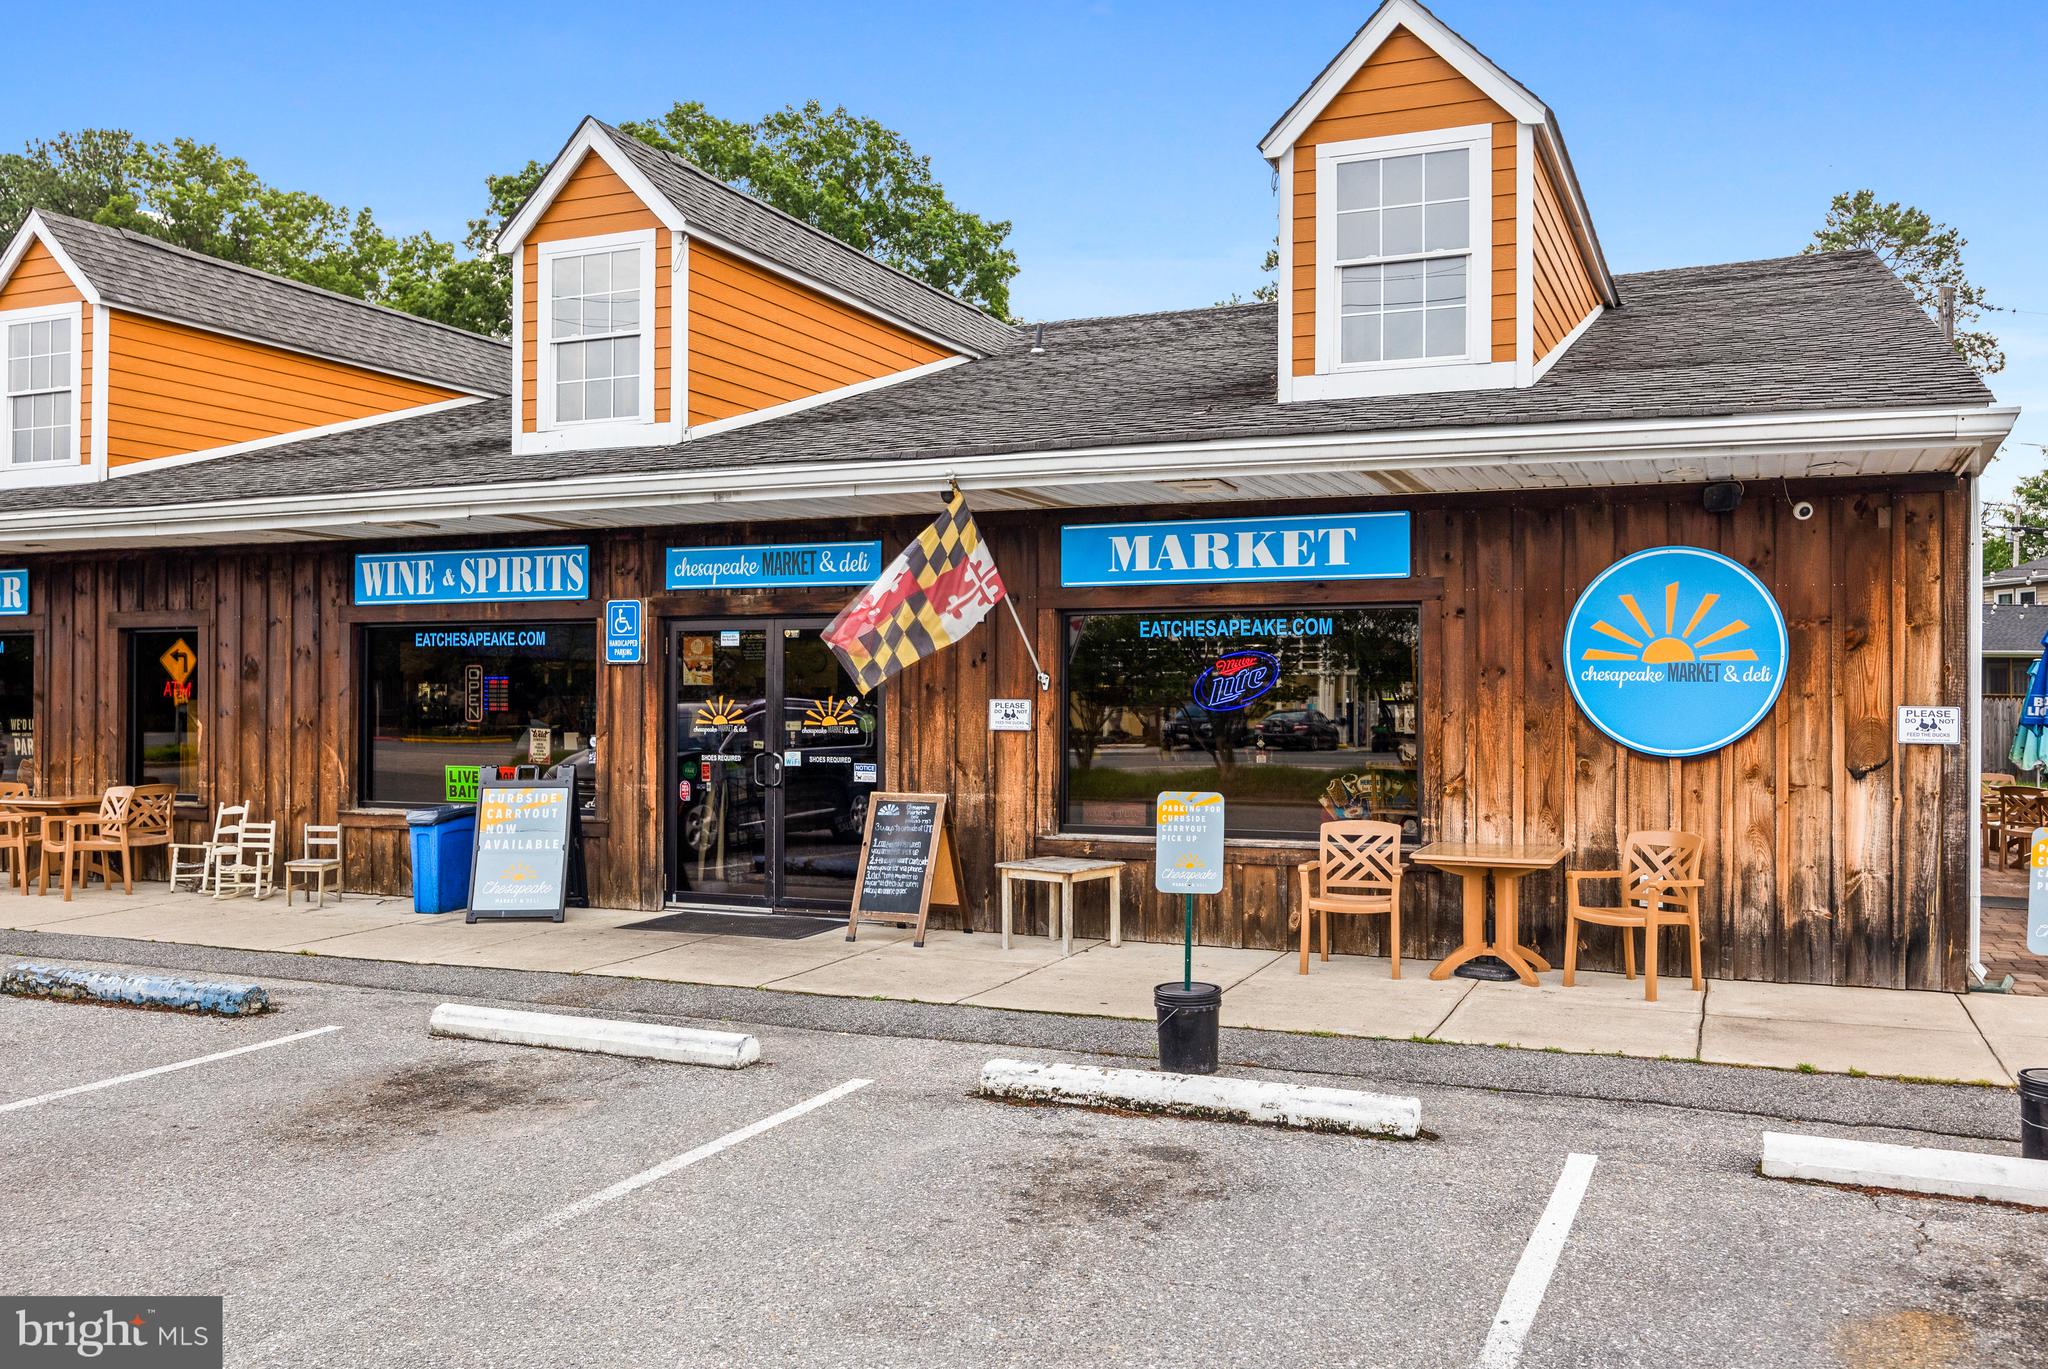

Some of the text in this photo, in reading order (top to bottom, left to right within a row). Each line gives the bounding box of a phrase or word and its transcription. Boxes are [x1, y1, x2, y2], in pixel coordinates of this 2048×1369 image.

[1107, 527, 1357, 573] MARKET
[674, 550, 871, 585] chesapeake MARKET & deli
[362, 553, 584, 597] WINE & SPIRITS
[0, 577, 22, 608] R
[1139, 617, 1333, 639] EATCHESAPEAKE.COM
[415, 631, 546, 647] EATCHESAPEAKE.COM
[609, 639, 638, 647] HANDICAPPED
[614, 648, 633, 656] PARKING
[1215, 655, 1258, 675] Miller
[1581, 663, 1773, 688] chesapeake MARKET & deli
[163, 681, 192, 697] ATM
[1208, 666, 1268, 707] Lite
[468, 668, 480, 719] OPEN
[1906, 710, 1951, 718] PLEASE
[11, 719, 27, 731] WE'D
[828, 726, 844, 734] MARKET
[449, 770, 479, 784] LIVE
[449, 785, 478, 798] BAIT
[488, 792, 557, 804] CURBSIDE
[487, 808, 558, 819] CARRYOUT
[1162, 805, 1220, 813] PARKING FOR
[1162, 815, 1206, 823] CURBSIDE
[486, 824, 517, 835] NOW
[1161, 825, 1207, 833] CARRYOUT
[483, 839, 559, 850] AVAILABLE
[1161, 834, 1182, 842] PICK
[1161, 868, 1217, 882] Chesapeake
[482, 881, 554, 898] Chesapeake
